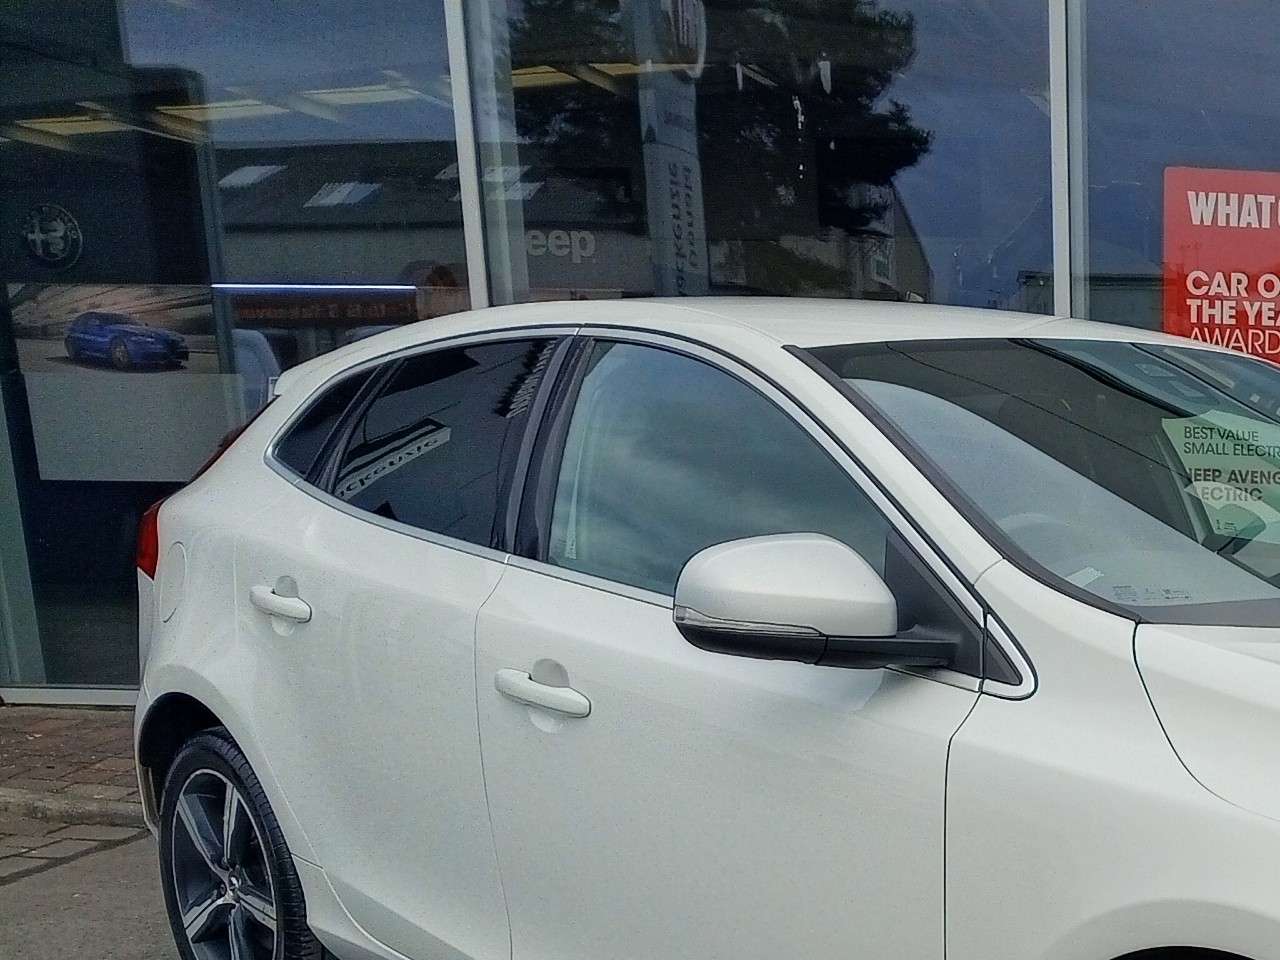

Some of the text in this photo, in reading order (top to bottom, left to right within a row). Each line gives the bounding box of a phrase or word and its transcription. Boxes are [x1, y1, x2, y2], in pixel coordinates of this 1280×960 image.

[1187, 190, 1275, 228] WHAT
[527, 229, 596, 263] eep
[1186, 270, 1249, 298] CAR
[1186, 298, 1237, 325] THE
[1184, 426, 1259, 442] BEST VALUE
[1183, 441, 1230, 456] SMALL
[1196, 485, 1264, 502] ECTRIC
